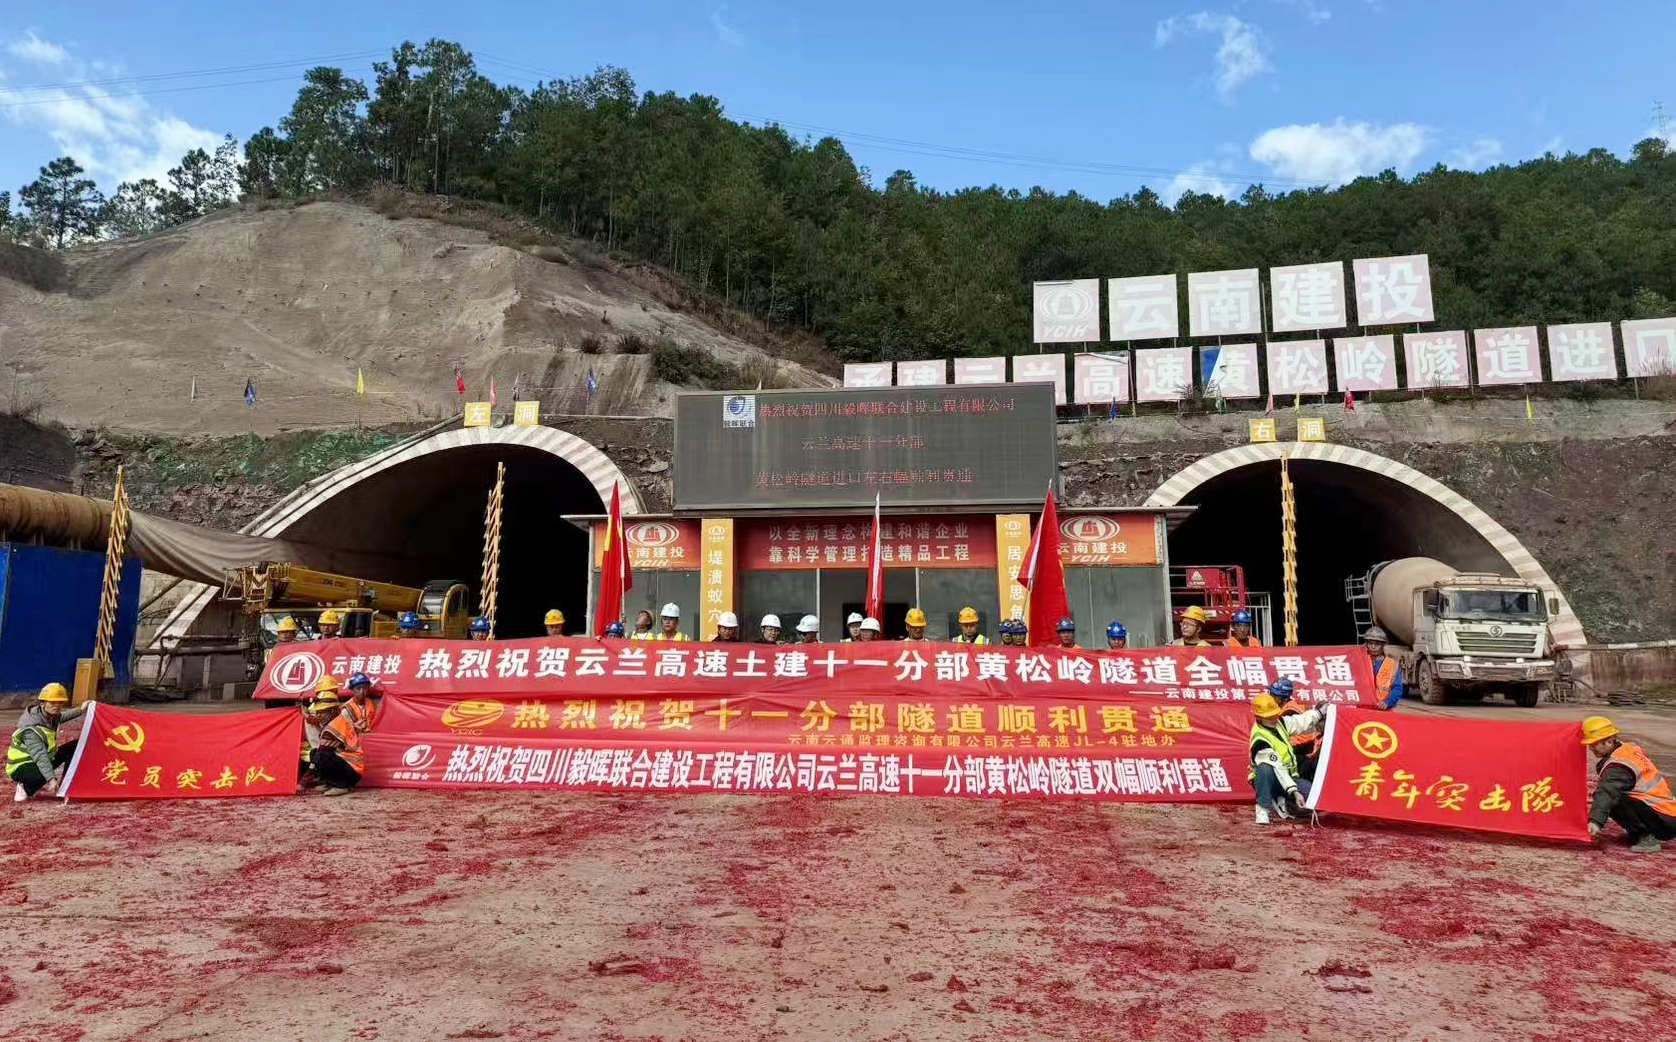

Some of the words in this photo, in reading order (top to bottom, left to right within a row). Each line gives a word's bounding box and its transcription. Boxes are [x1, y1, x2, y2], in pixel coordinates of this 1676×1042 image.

[1117, 262, 1427, 334] 云南建投
[1256, 421, 1322, 439] 右洞
[769, 523, 970, 541] 以全新理念构建和谐企业
[331, 653, 402, 675] 云南建投
[415, 647, 1356, 687] 热烈祝贺云兰高速土建十一分部黄松岭隧道全幅贯通
[511, 698, 1194, 734] 热烈祝贺十一分部隧道顺利贯通
[101, 759, 276, 790] 党员突击队
[442, 744, 1232, 795] 热烈祝贺四川毅晖联合建设工程有限公司云兰高速十一分部黄松岭隧道双幅顺利贯通
